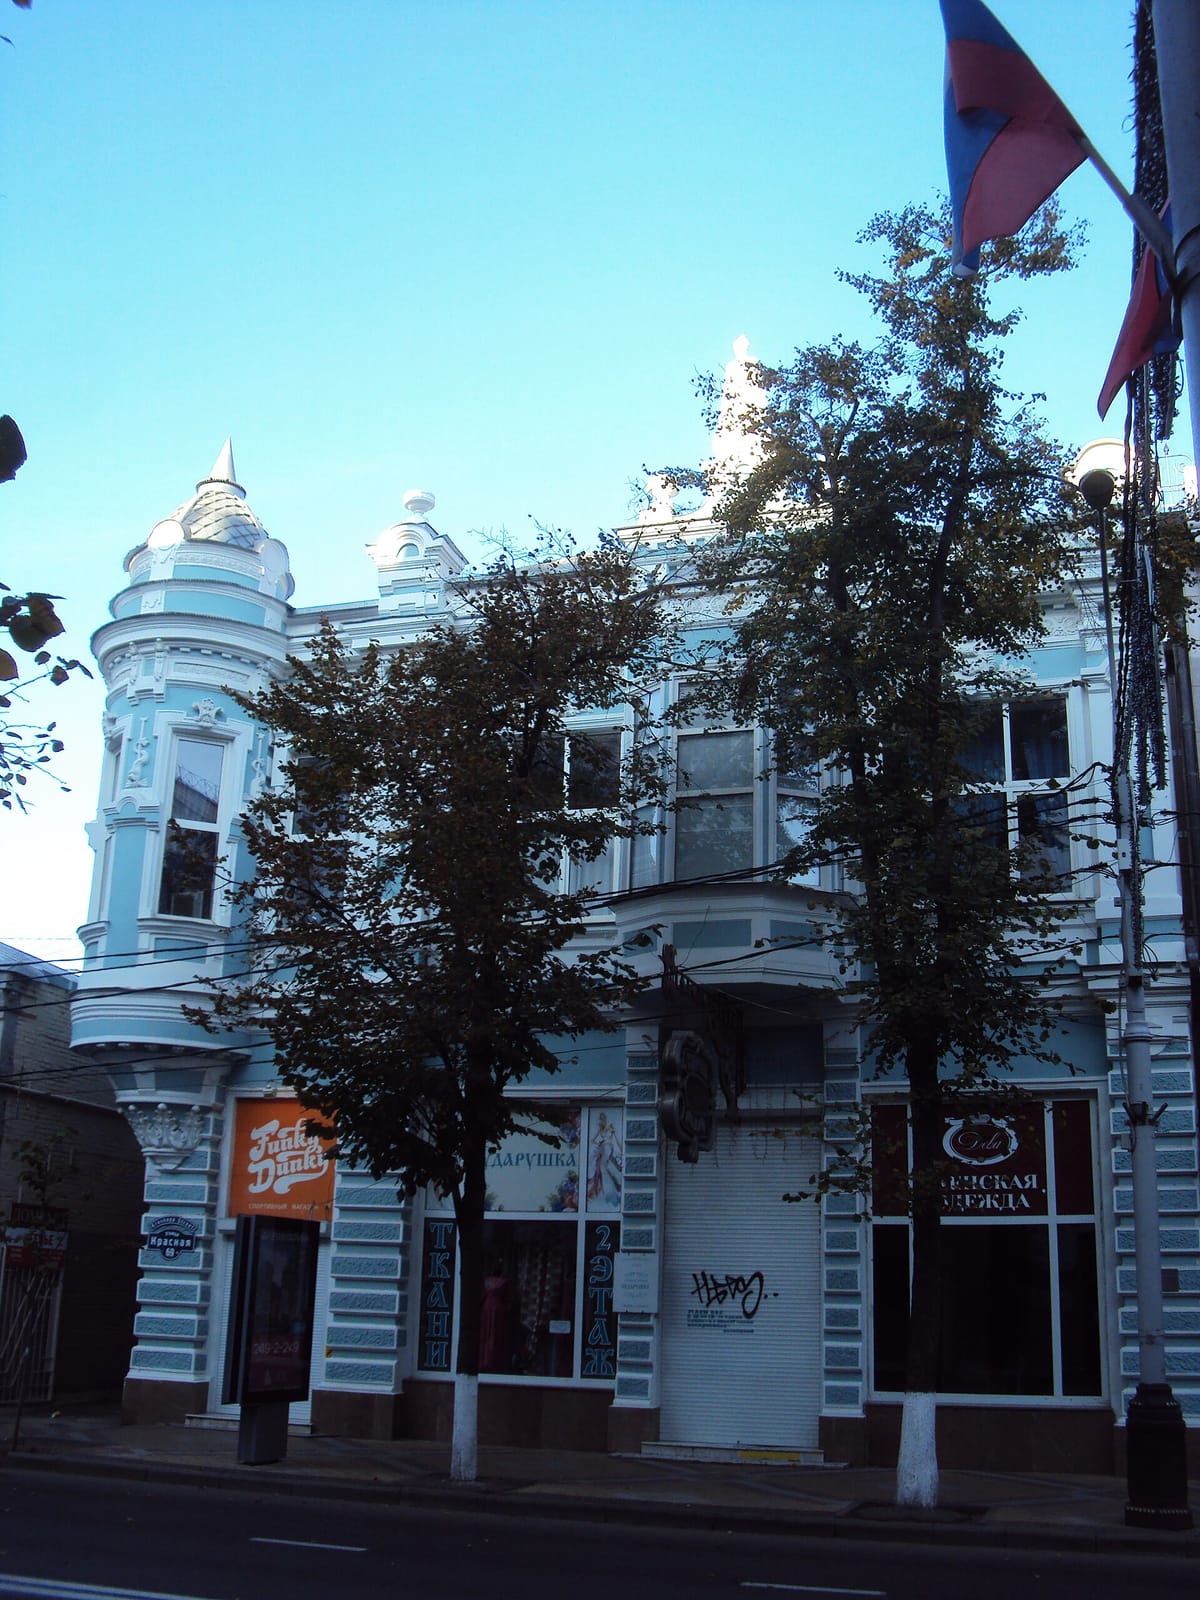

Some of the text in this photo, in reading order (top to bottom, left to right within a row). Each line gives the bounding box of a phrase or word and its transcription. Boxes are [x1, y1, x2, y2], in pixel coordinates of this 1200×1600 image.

[249, 1118, 320, 1161] Funky
[248, 1147, 330, 1195] Dunky
[485, 1152, 577, 1172] ДАРУШКА
[941, 1174, 1039, 1191] ЕНСКАЯ
[149, 1235, 192, 1248] Красная
[424, 1222, 454, 1368] ТКАНИ
[583, 1224, 615, 1376] 2 ЭТАЖ
